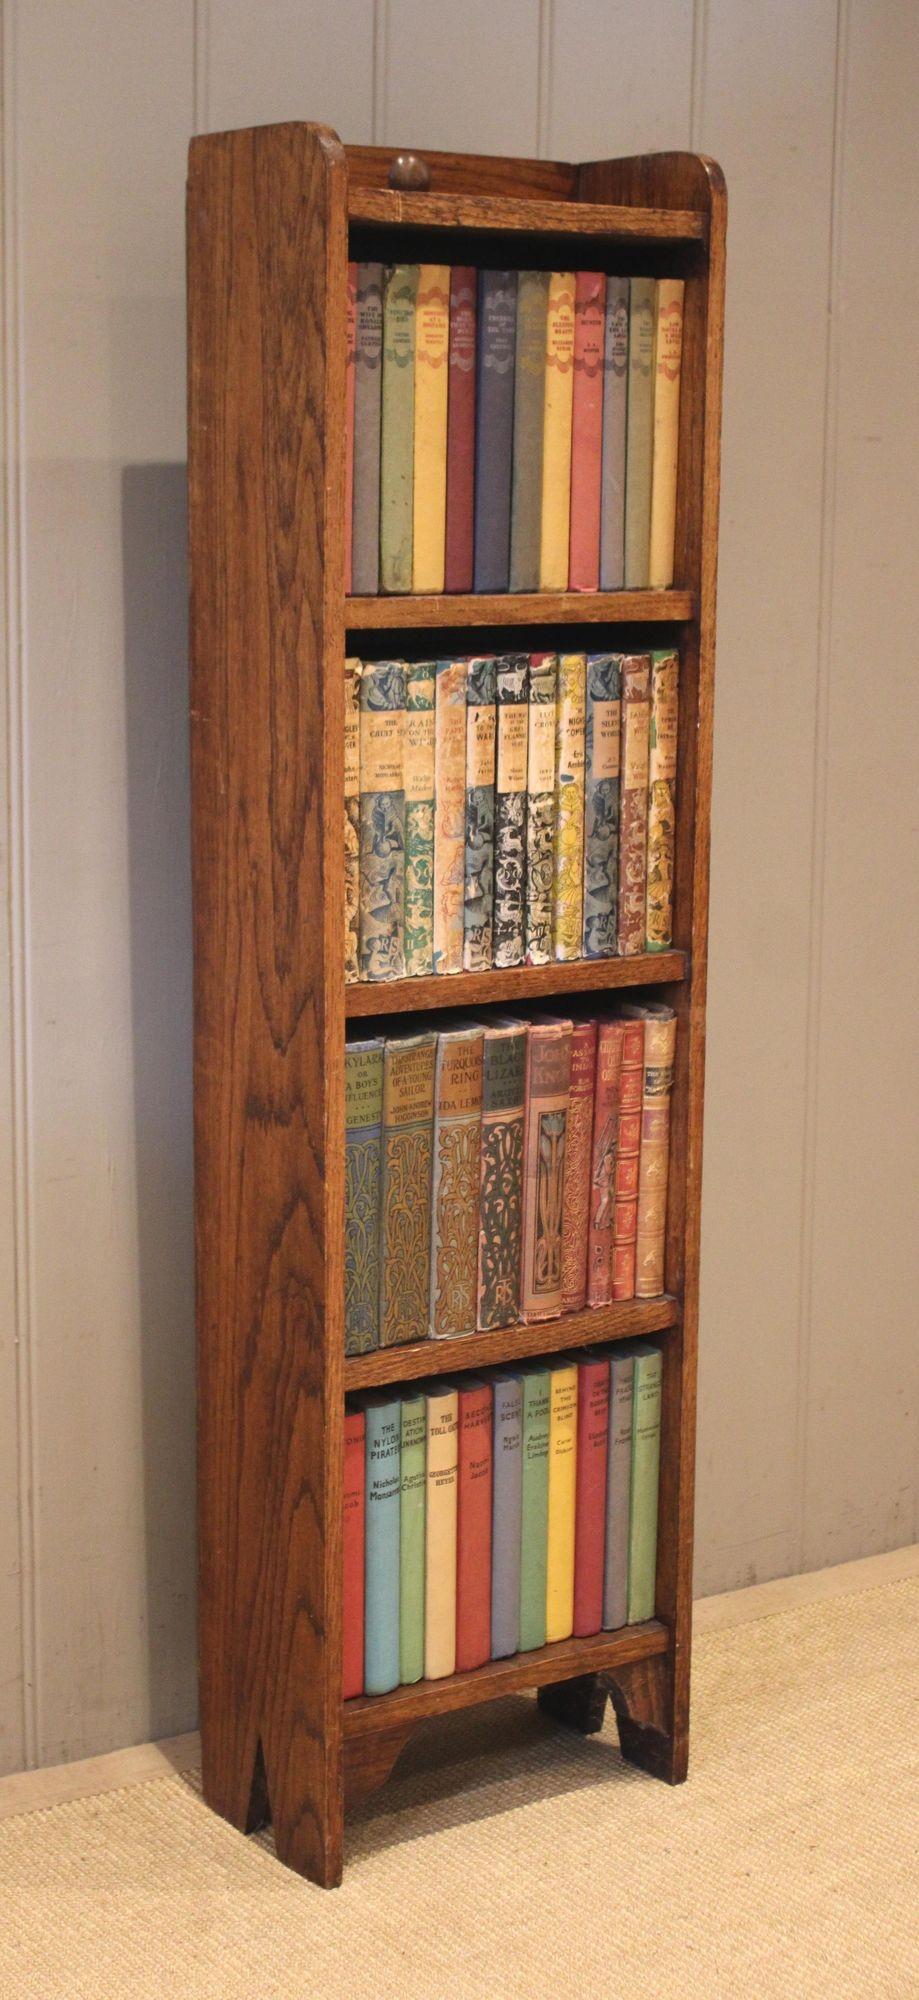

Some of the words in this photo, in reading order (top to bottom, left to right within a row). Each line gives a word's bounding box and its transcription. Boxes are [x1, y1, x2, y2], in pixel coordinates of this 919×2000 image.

[384, 719, 398, 727] THE
[408, 719, 435, 728] RAIN
[568, 718, 585, 726] NIGH
[600, 720, 618, 728] SILEN
[369, 730, 393, 738] CRUEL
[475, 732, 495, 742] WAR
[566, 728, 585, 737] COME
[601, 730, 619, 738] WORL
[567, 760, 585, 769] Amble
[457, 1045, 474, 1056] THE
[442, 1055, 484, 1072] TURQUOIS
[451, 1071, 480, 1085] RING
[486, 1065, 522, 1081] LIZAR
[399, 1083, 426, 1098] SAILOR
[438, 1101, 457, 1111] IDA
[560, 1395, 572, 1403] THE
[440, 1412, 453, 1424] THE
[527, 1411, 533, 1419] A
[381, 1423, 395, 1435] THE
[405, 1426, 424, 1438] ATION
[430, 1425, 447, 1437] TOLL
[370, 1445, 401, 1460] PIRATE
[373, 1477, 400, 1489] Nichola
